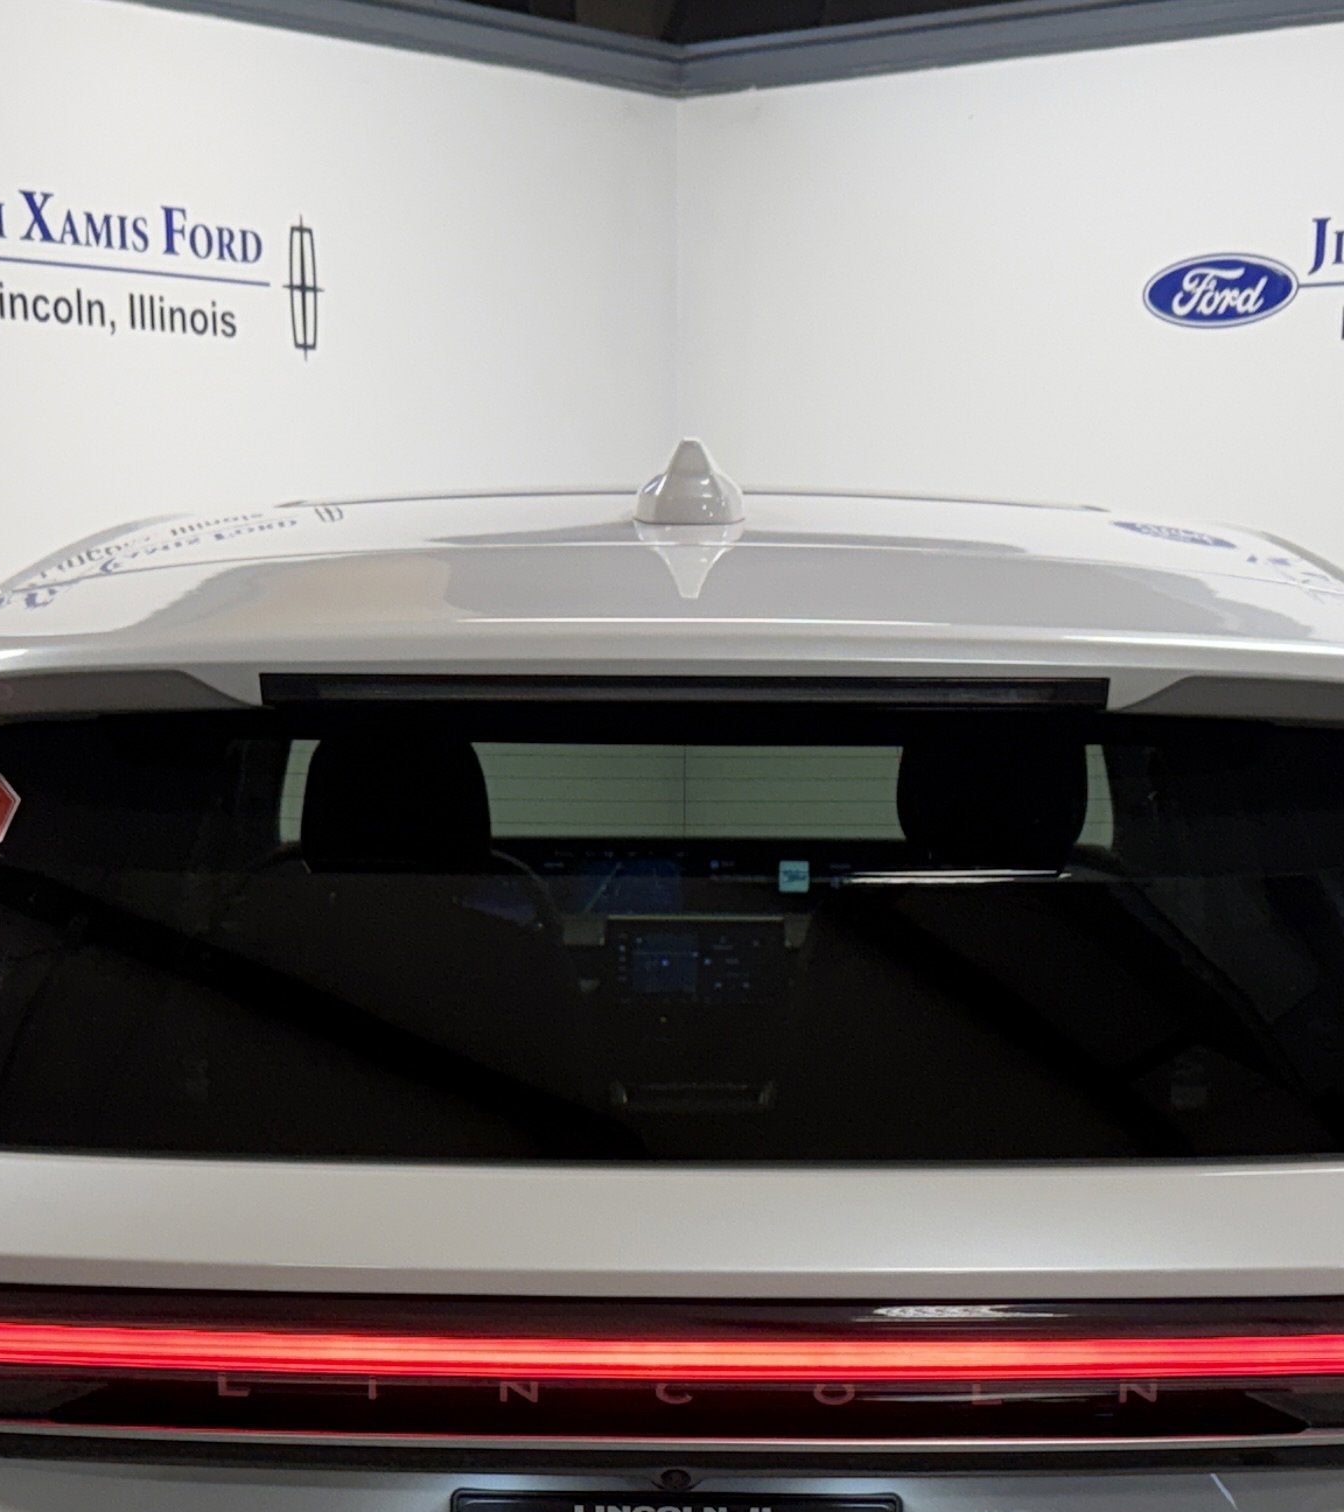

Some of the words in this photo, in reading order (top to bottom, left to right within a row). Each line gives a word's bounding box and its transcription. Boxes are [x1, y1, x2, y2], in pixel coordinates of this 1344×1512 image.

[19, 190, 149, 252] XAMIS
[161, 206, 263, 263] FORD
[129, 293, 237, 338] Illinois
[1172, 264, 1265, 316] Ford
